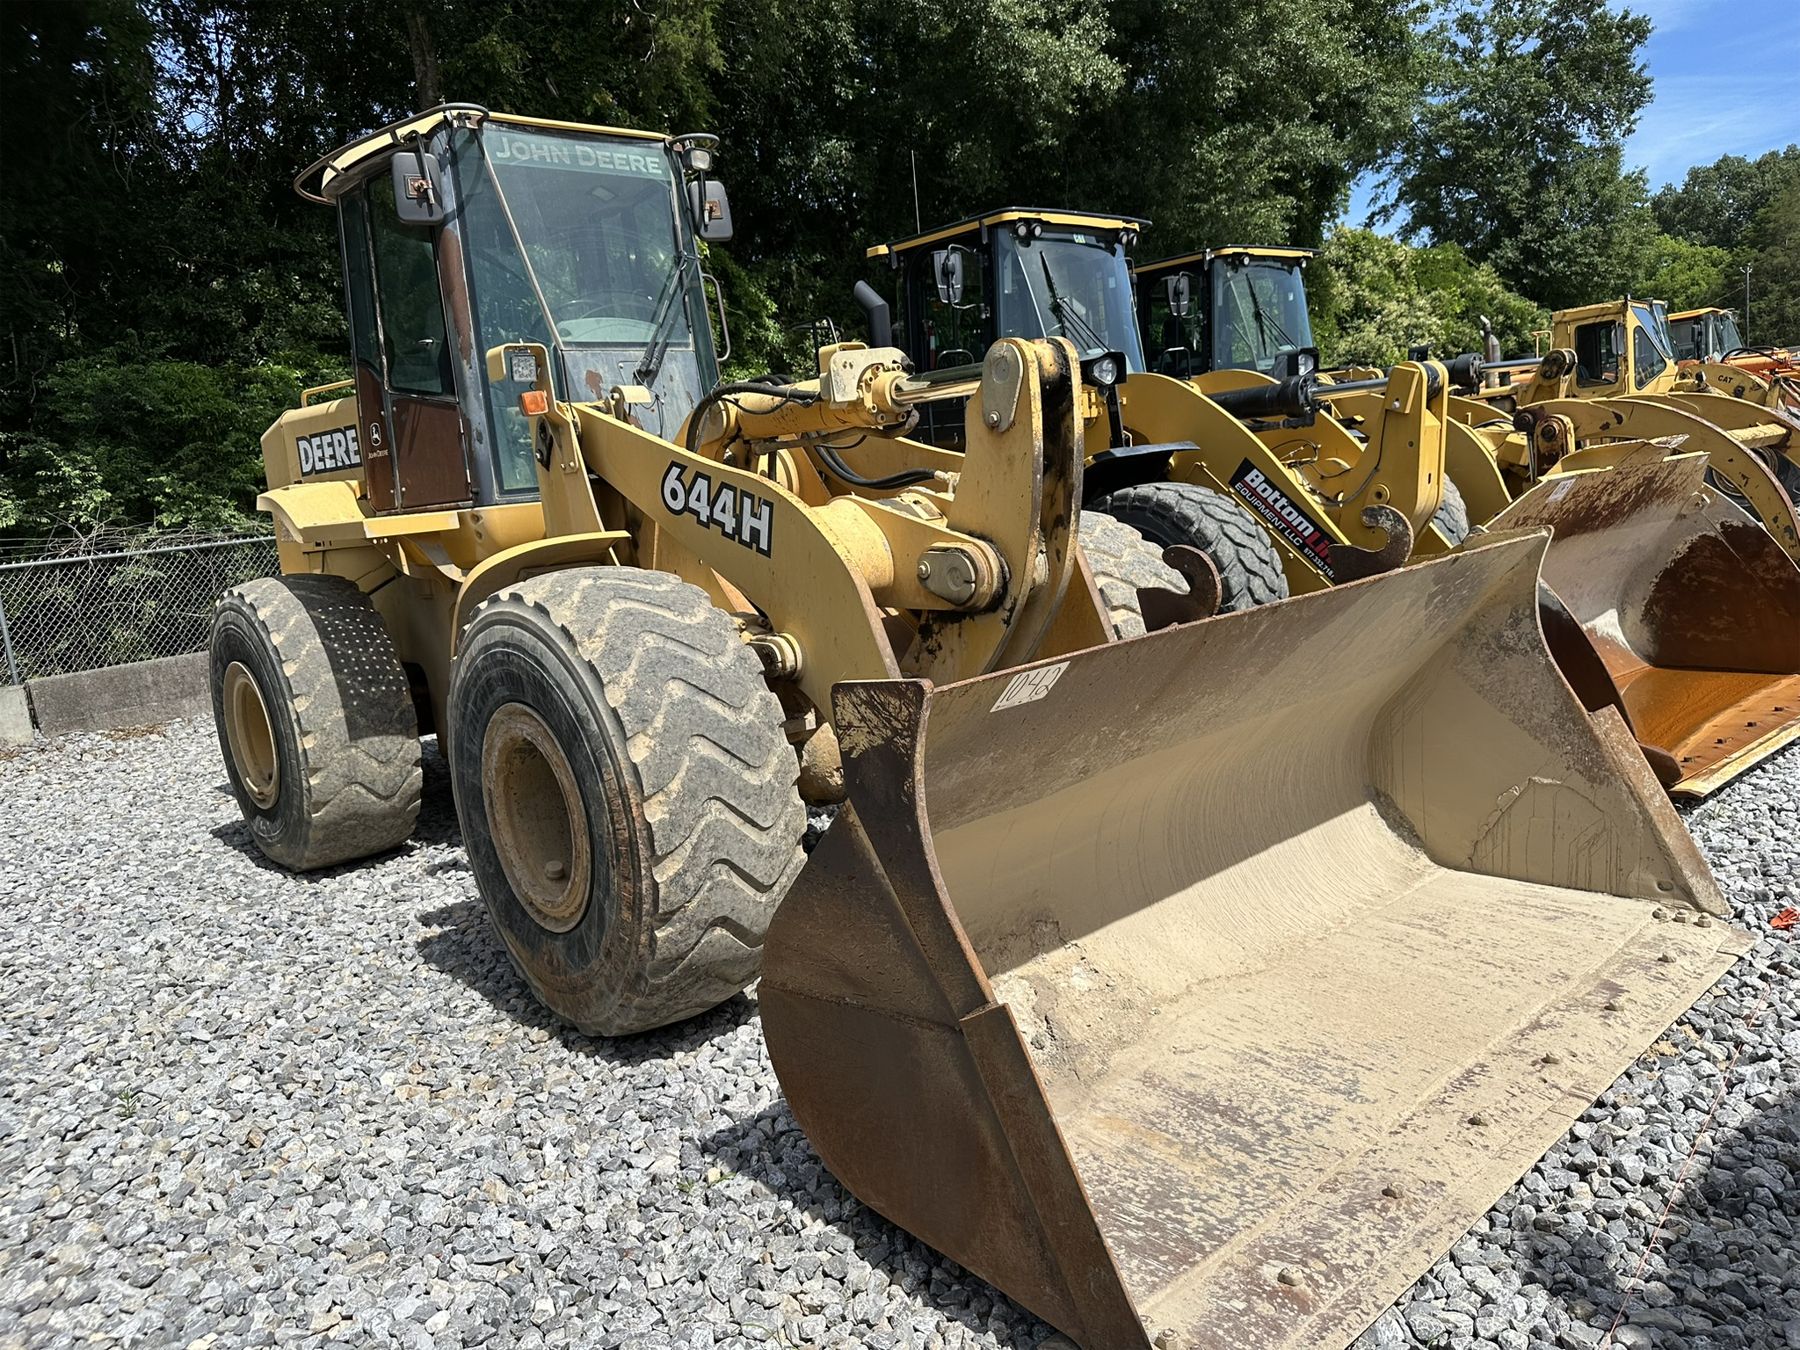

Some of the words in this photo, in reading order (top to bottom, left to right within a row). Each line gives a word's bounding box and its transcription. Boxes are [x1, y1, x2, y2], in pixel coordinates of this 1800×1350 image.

[496, 137, 571, 165] JOHN
[575, 145, 662, 174] DEERE
[1717, 374, 1733, 384] CAT
[297, 428, 361, 473] DEERE
[662, 462, 773, 556] 644H
[1234, 482, 1287, 532] EQUIPMENT
[1284, 528, 1303, 546] LLC
[1243, 468, 1332, 565] BottomLi
[1000, 666, 1061, 703] 1042
